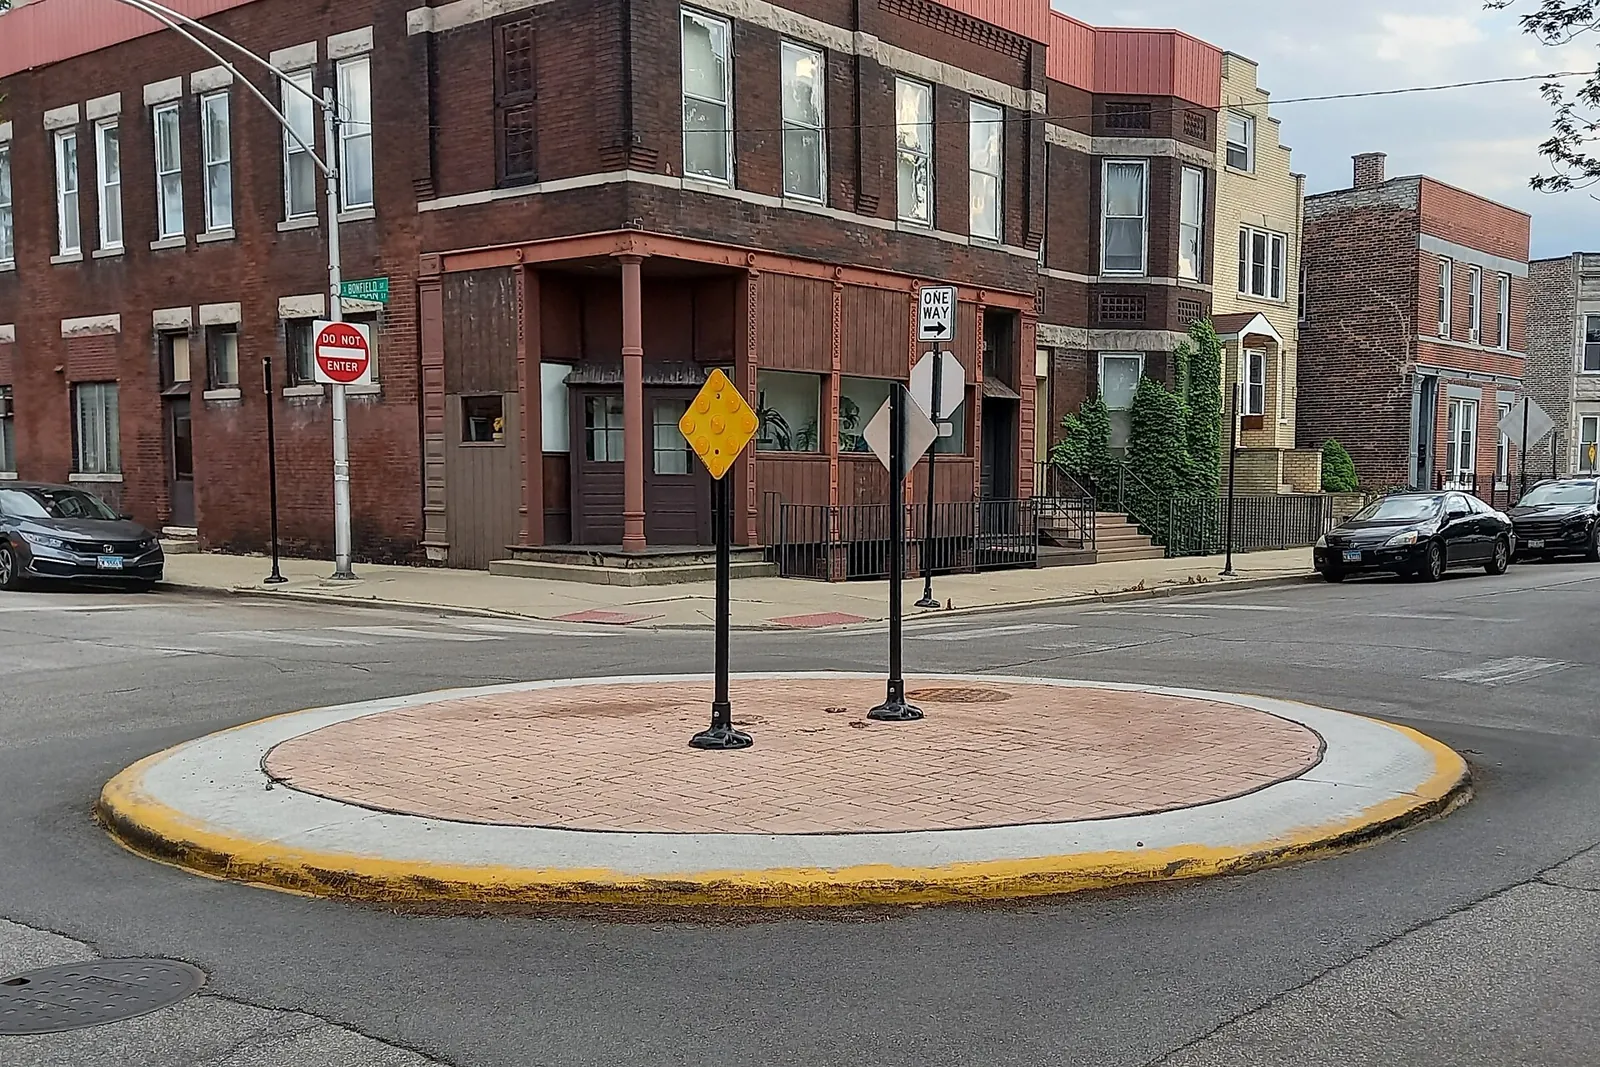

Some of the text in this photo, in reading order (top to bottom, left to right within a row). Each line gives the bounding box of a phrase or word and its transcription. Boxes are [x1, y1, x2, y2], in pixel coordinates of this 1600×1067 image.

[348, 281, 378, 294] BONFIELD
[924, 292, 949, 304] ONE
[923, 307, 949, 319] WAY
[322, 333, 361, 346] DO NOT
[327, 360, 358, 372] ENTER
